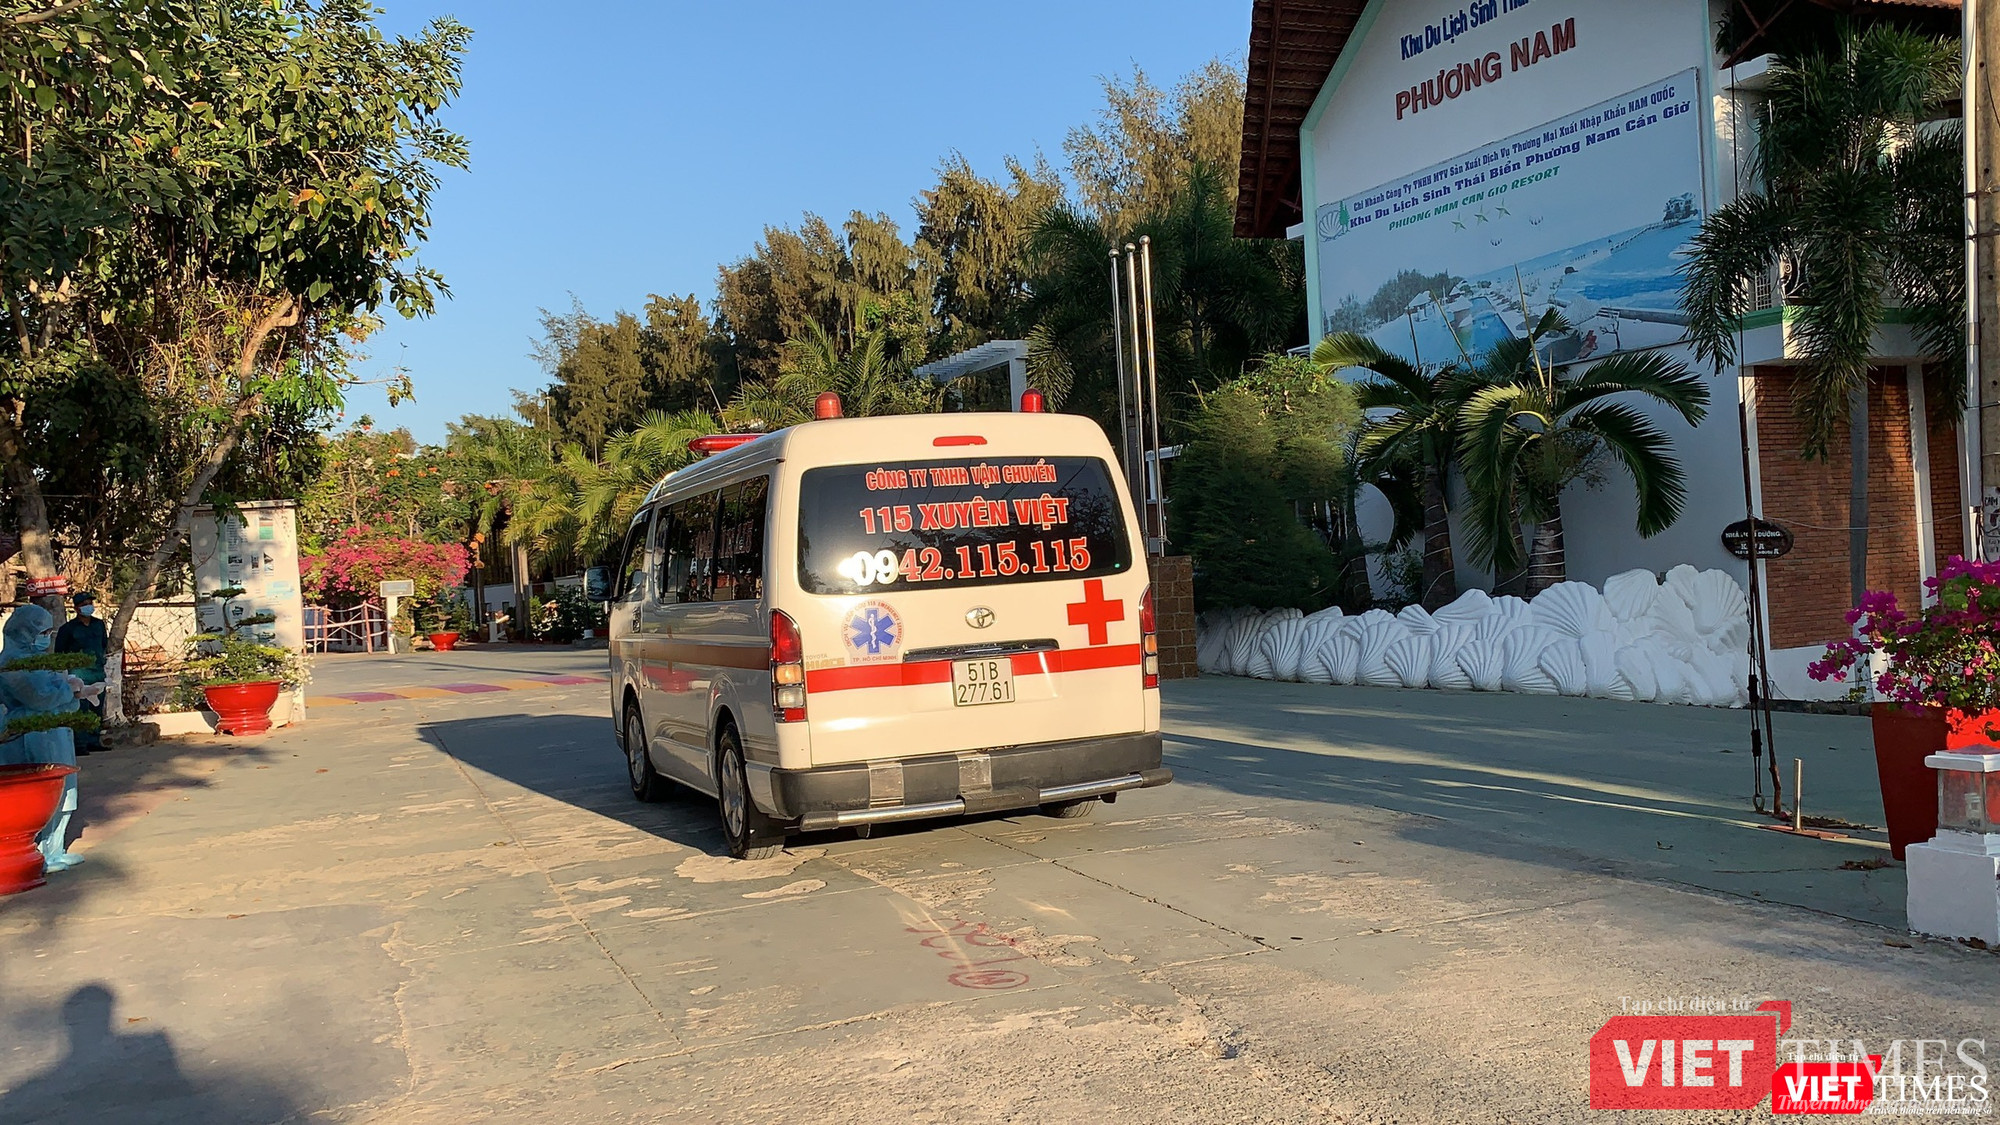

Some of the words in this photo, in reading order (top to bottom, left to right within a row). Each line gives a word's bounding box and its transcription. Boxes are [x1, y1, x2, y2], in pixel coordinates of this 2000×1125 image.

[1400, 34, 1424, 60] Khu
[1424, 25, 1441, 49] Du
[1442, 10, 1468, 44] Lịch
[1469, 0, 1498, 28] Sinh
[1395, 52, 1502, 120] PHƯƠNG
[1510, 17, 1576, 72] NAM
[1350, 214, 1372, 229] Khu
[1374, 208, 1390, 220] Du
[1393, 197, 1419, 212] Lịch
[1422, 185, 1451, 203] Sinh
[1454, 172, 1486, 191] Thái
[1489, 160, 1521, 180] Biển
[1525, 141, 1581, 167] Phương
[1585, 127, 1621, 147] Nam
[1625, 114, 1658, 132] Cần
[1662, 100, 1691, 119] Giờ
[1412, 175, 1432, 190] TNHH
[1433, 169, 1449, 183] MTV
[1464, 155, 1481, 172] Xuất
[1482, 151, 1499, 166] Dịch
[1500, 147, 1510, 159] Vụ
[1511, 137, 1541, 154] Thương
[1559, 120, 1578, 137] Xuất
[1579, 115, 1602, 130] Nhập
[1603, 103, 1626, 122] Khẩu
[1628, 96, 1648, 113] NAM
[1650, 84, 1675, 105] QUỐC
[1388, 210, 1431, 231] PHUONG
[1434, 200, 1459, 216] NAM
[1461, 191, 1485, 206] CAN
[1487, 184, 1508, 198] GIO
[1511, 166, 1560, 190] RESORT
[866, 467, 907, 491] CÔNG
[909, 467, 928, 488] TY
[971, 462, 1001, 489] VẬN
[1002, 457, 1058, 484] CHUYỂN
[859, 504, 913, 535] 115
[917, 495, 1010, 532] XUYÊN
[1013, 492, 1070, 531] VIỆT
[850, 536, 1092, 586] 0942.115.115
[957, 681, 1010, 703] 277.61
[967, 661, 999, 682] 51B
